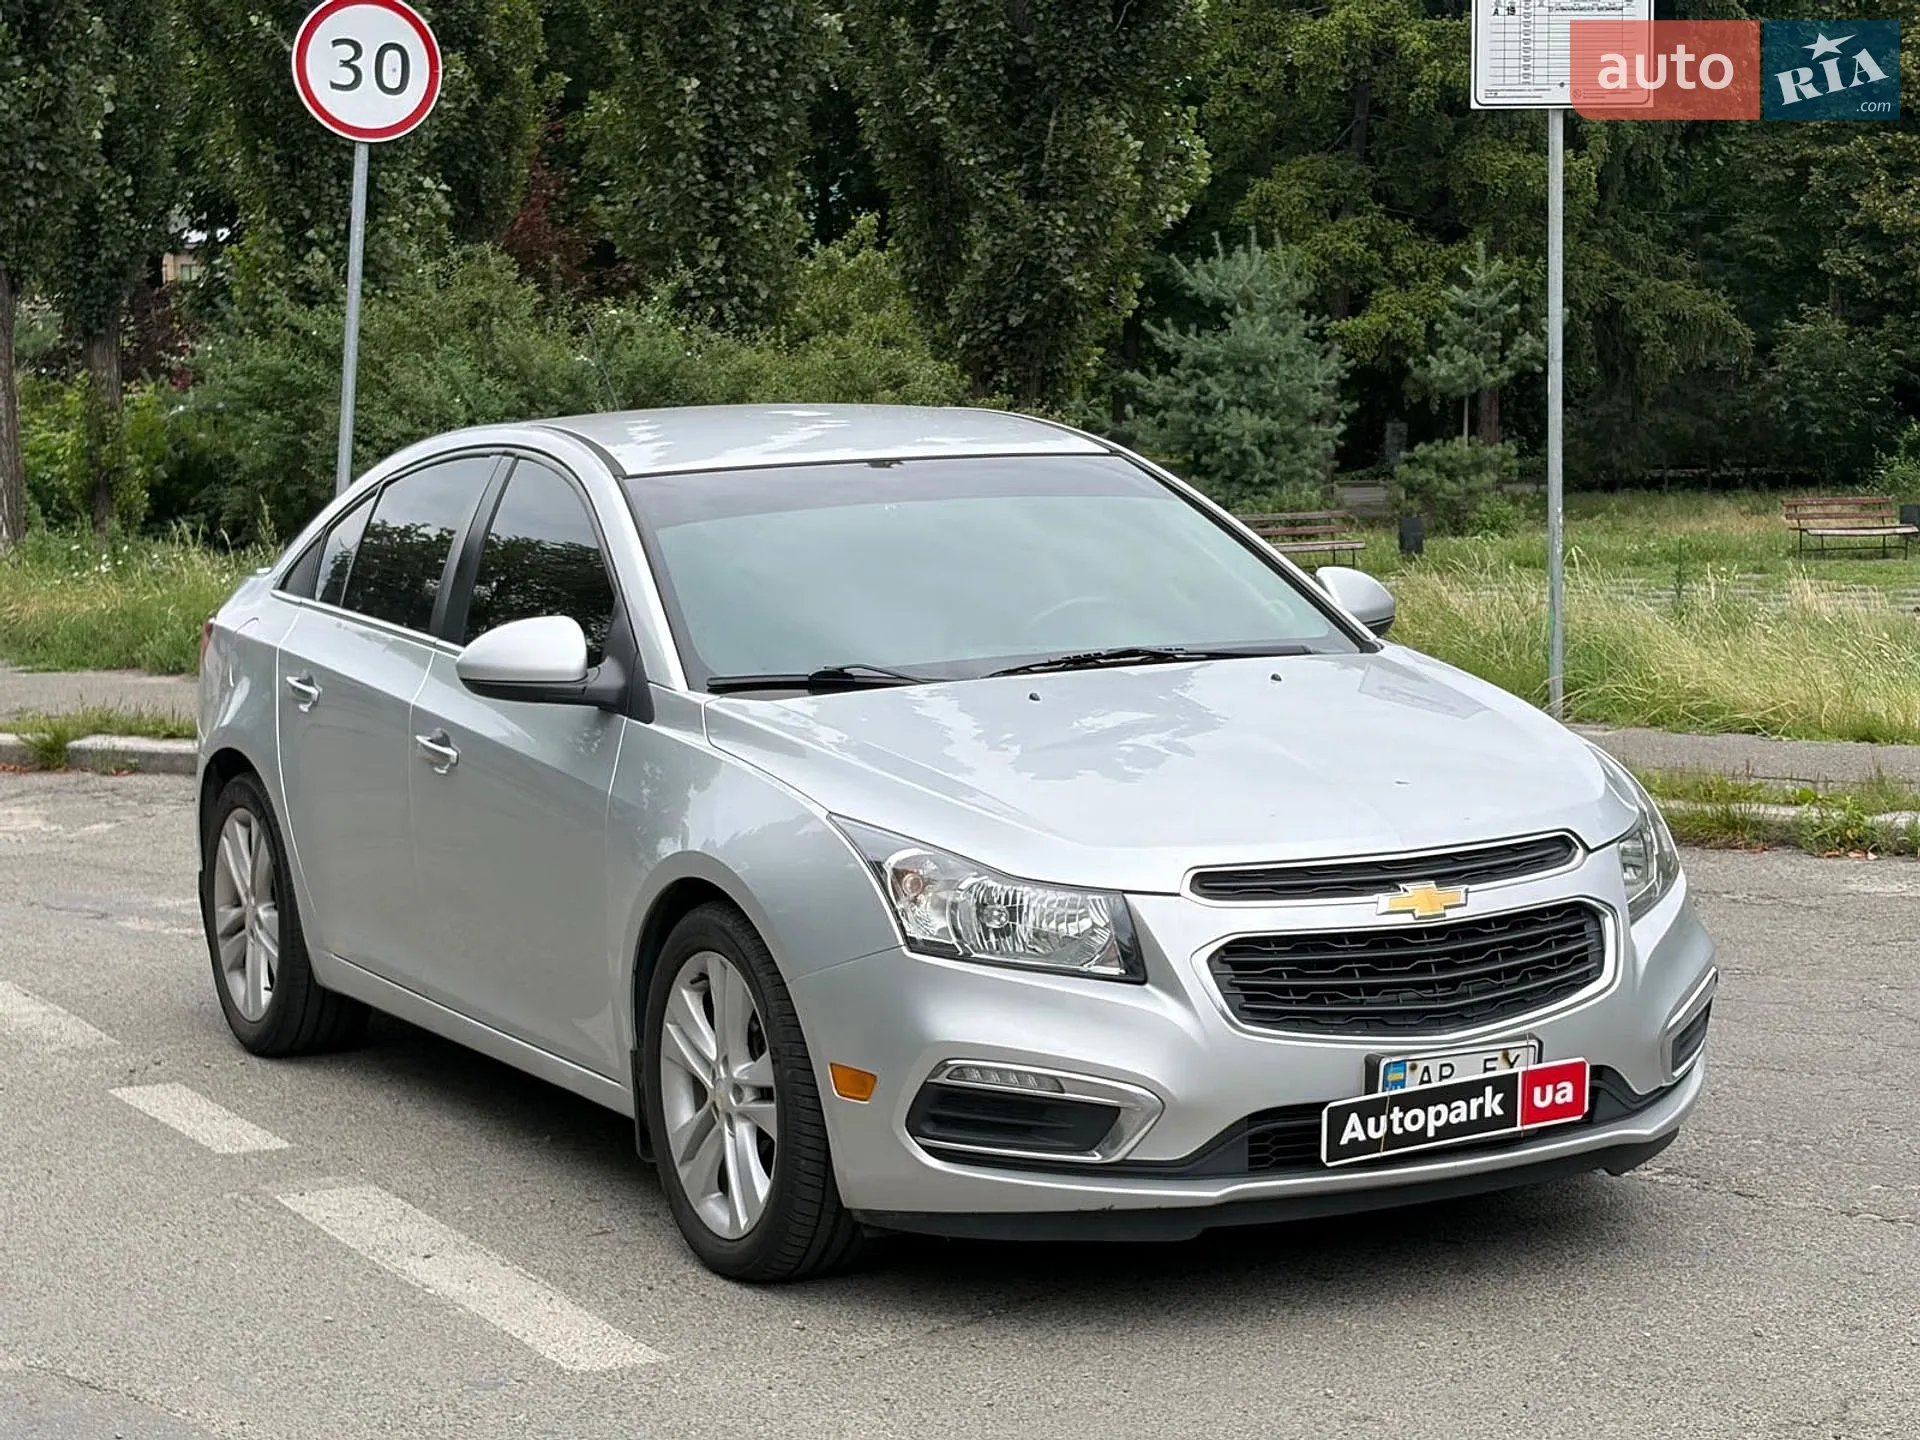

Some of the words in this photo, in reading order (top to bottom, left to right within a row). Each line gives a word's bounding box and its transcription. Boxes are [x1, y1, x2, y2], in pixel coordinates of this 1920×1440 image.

[329, 38, 411, 96] 30
[1339, 1086, 1505, 1146] Autopark
[1532, 1081, 1573, 1109] ua
